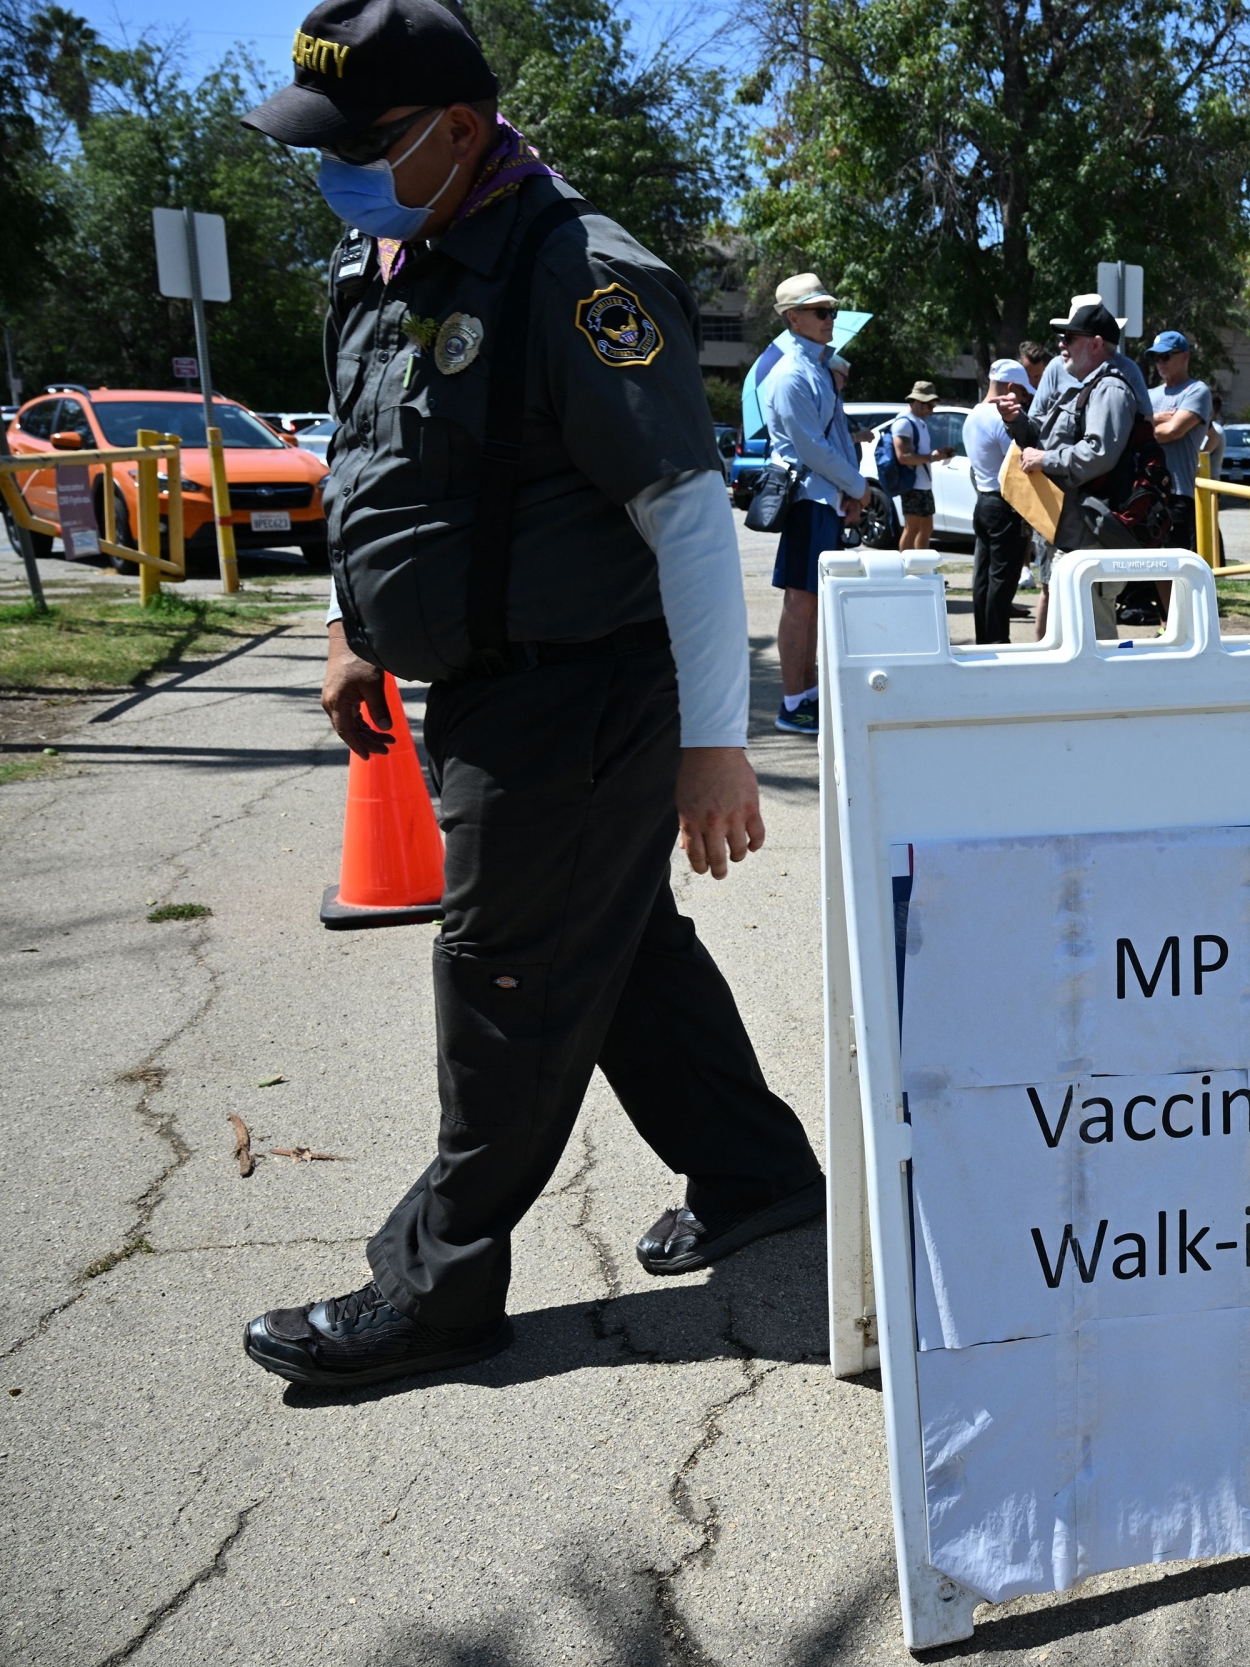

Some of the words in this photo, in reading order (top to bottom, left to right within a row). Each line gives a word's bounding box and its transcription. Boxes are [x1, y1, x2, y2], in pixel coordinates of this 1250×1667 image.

[591, 297, 623, 318] HAMILTON
[1112, 561, 1126, 569] FILL
[1127, 561, 1145, 569] WITH
[1146, 560, 1168, 568] SAND
[1116, 934, 1229, 999] MP
